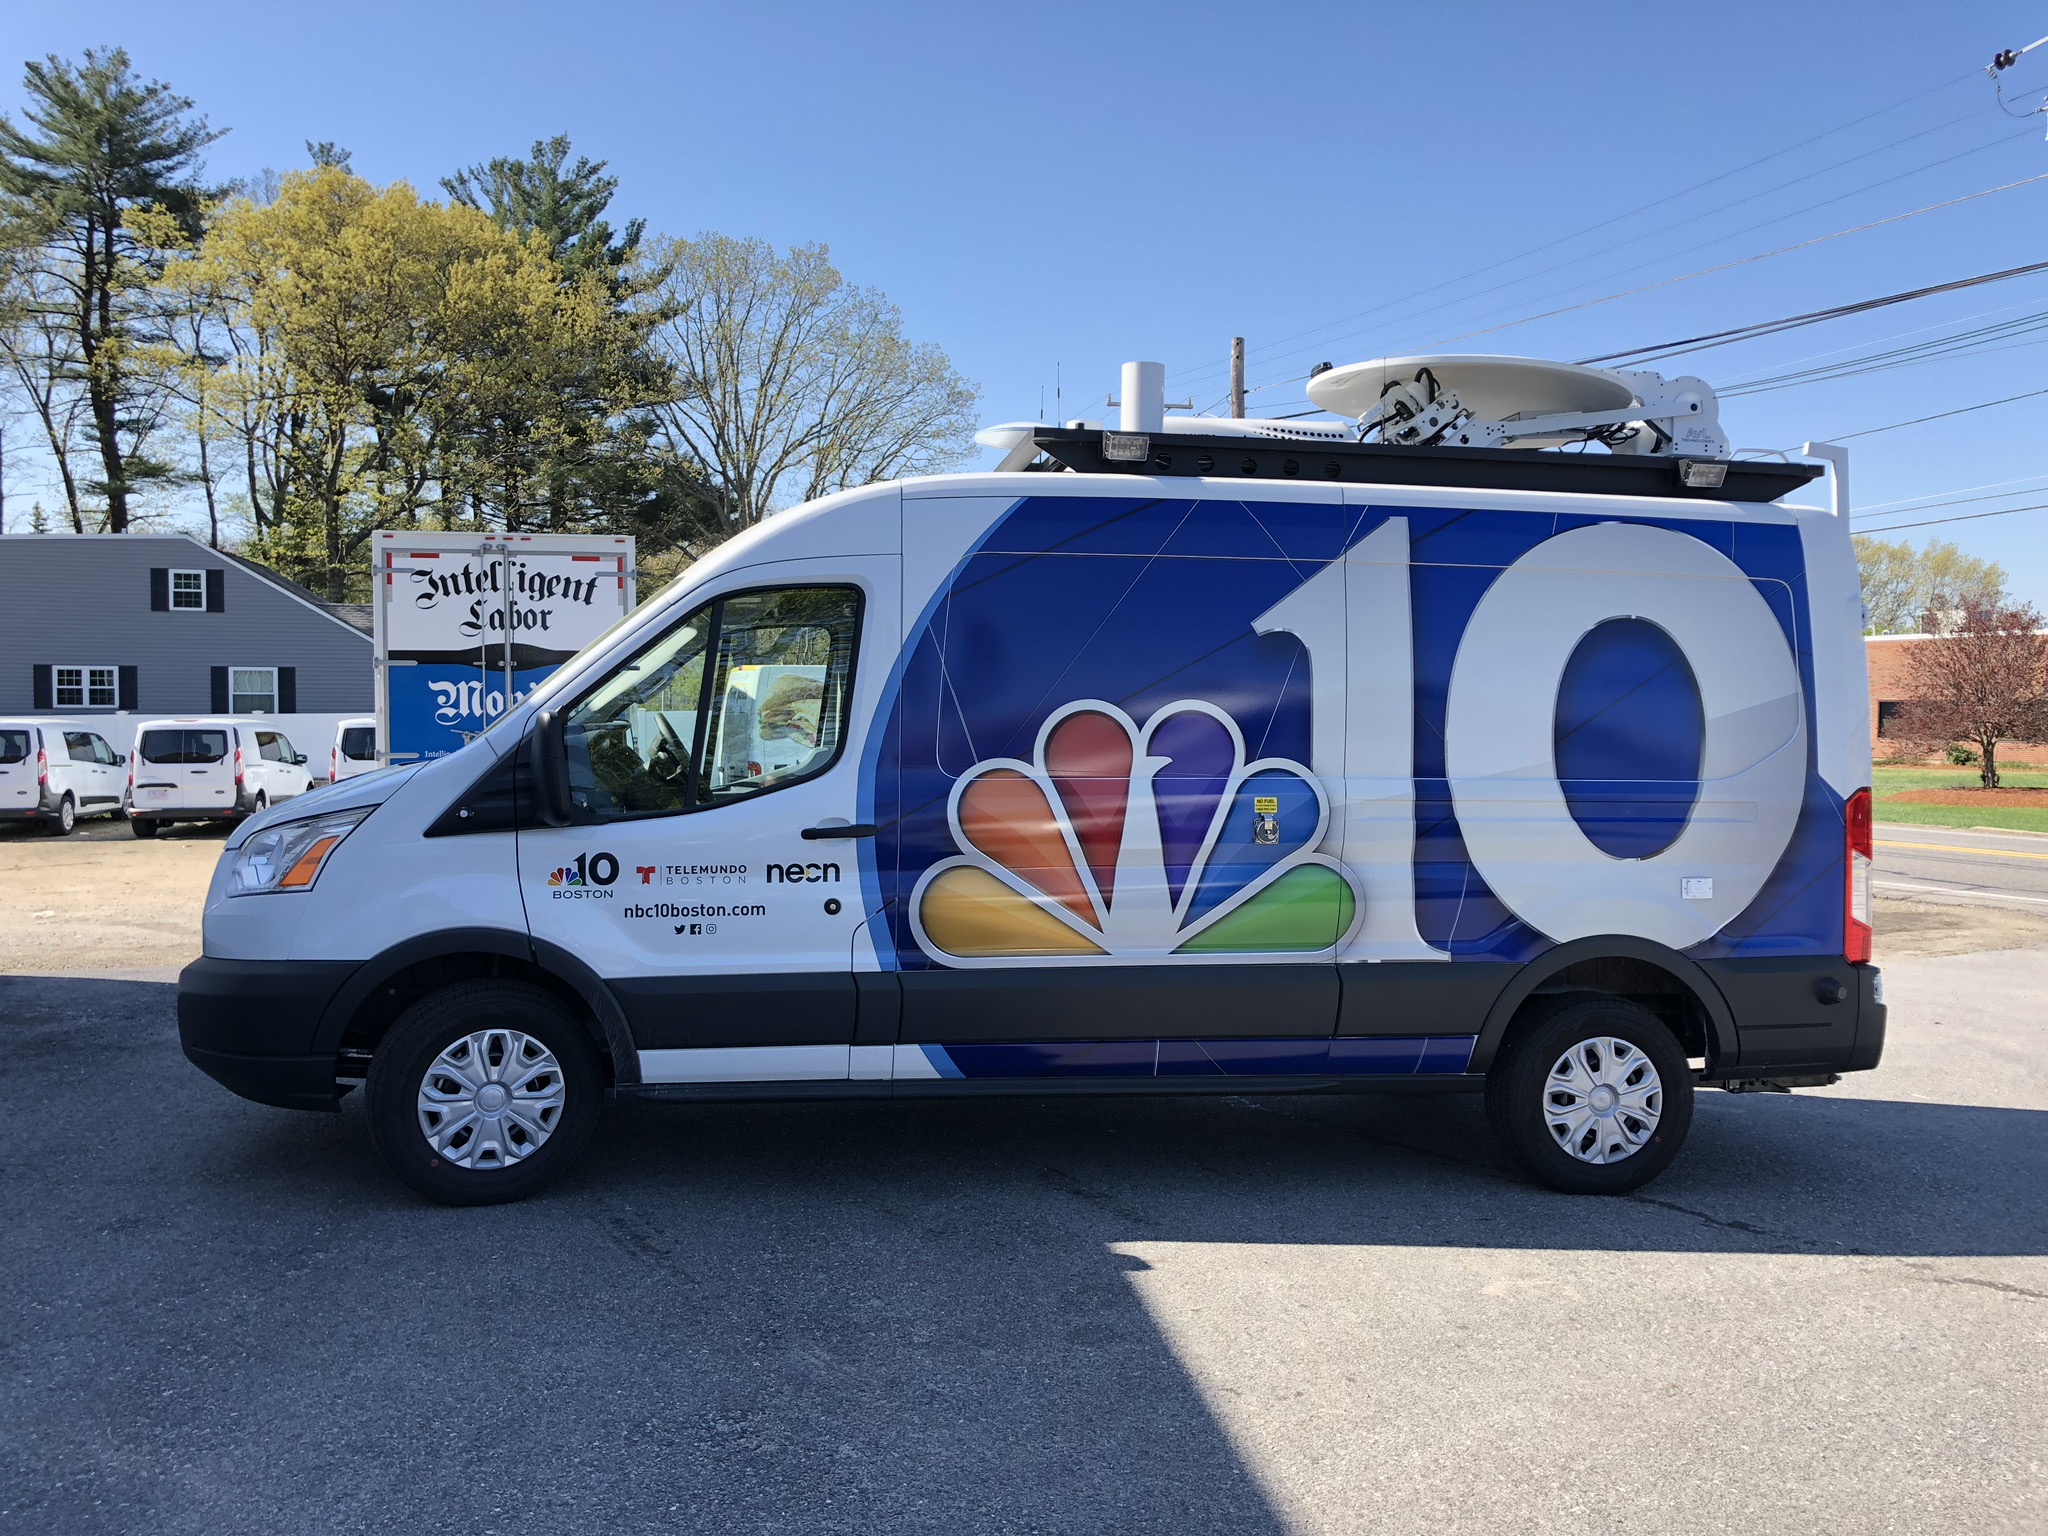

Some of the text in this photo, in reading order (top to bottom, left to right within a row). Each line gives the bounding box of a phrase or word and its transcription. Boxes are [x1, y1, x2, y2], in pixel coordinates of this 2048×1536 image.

[458, 599, 553, 637] Labor
[1251, 516, 1808, 962] 10
[573, 851, 620, 887] 10
[666, 864, 748, 875] TELEMUNDO
[766, 862, 841, 884] necn
[666, 875, 747, 886] BOSTON
[552, 889, 614, 900] BOSTON
[624, 903, 766, 919] nbc10boston.com
